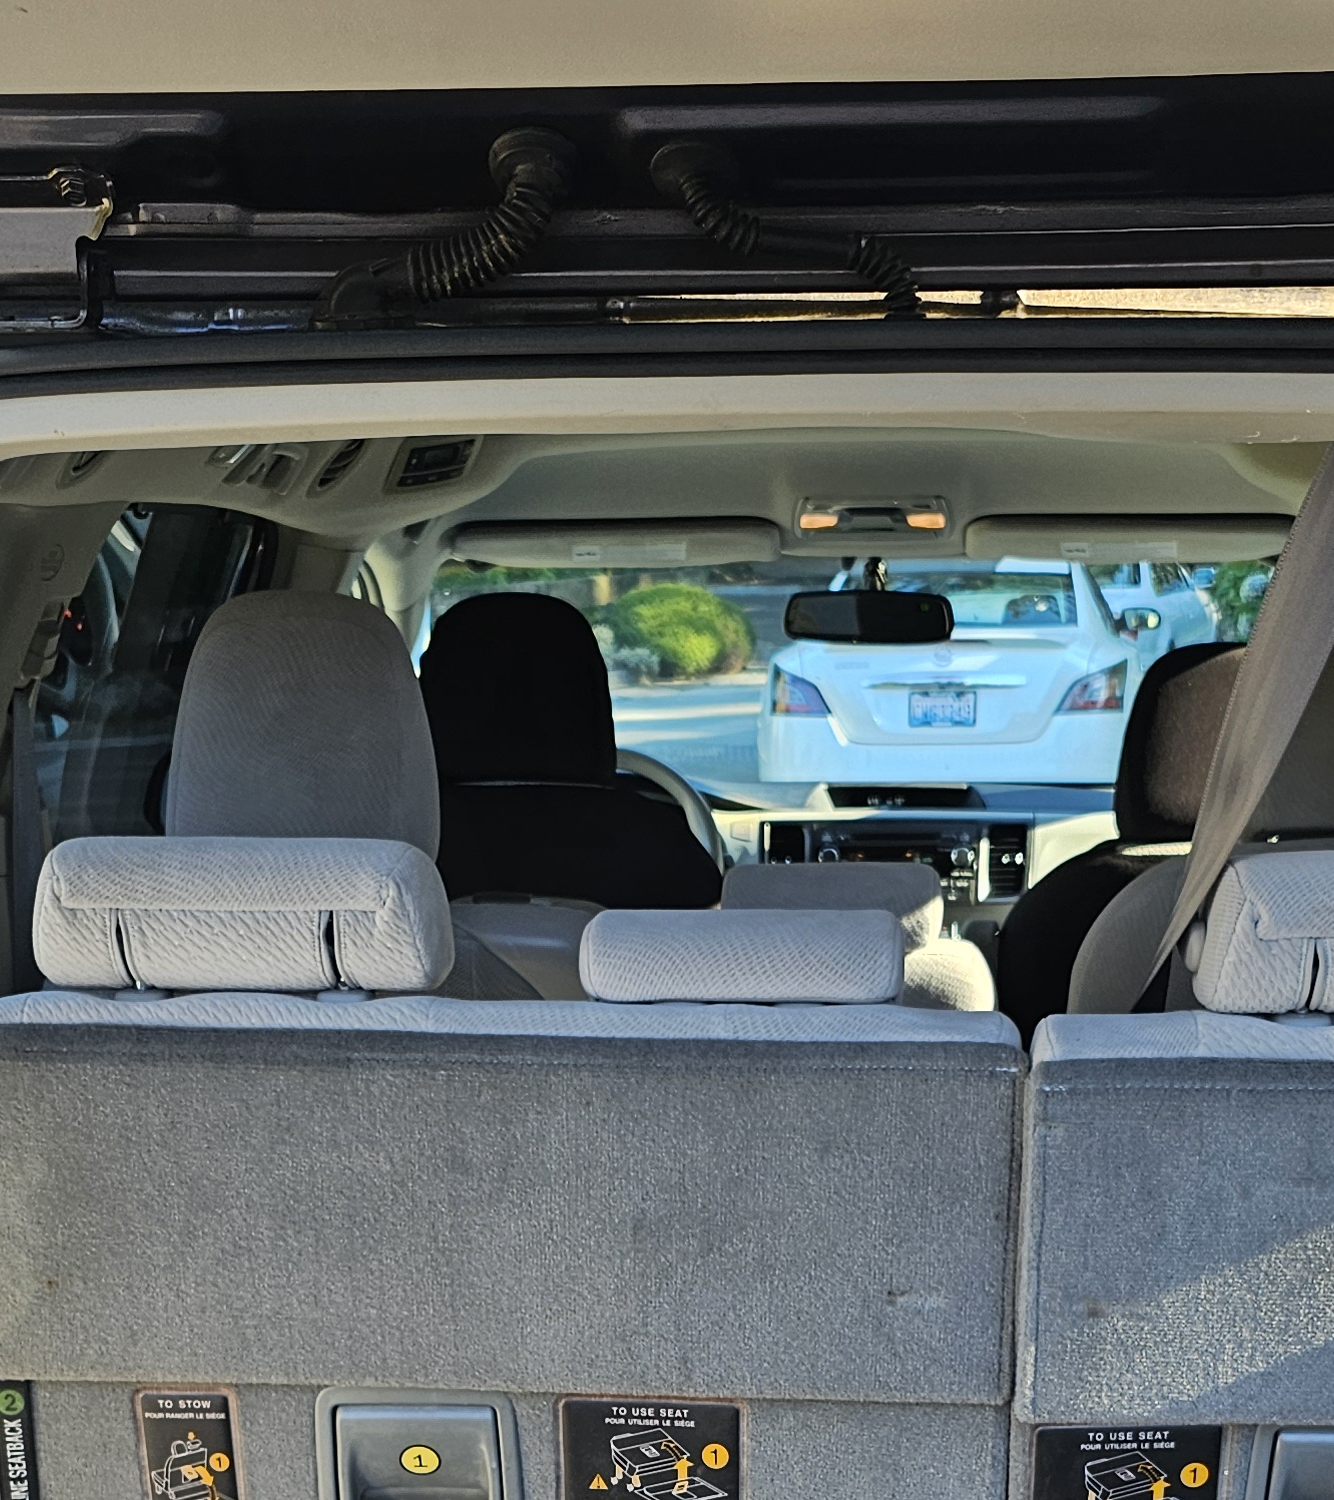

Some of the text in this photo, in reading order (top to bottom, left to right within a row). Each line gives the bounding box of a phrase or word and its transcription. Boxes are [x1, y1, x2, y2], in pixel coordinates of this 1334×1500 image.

[4, 1393, 19, 1412] 2
[158, 1400, 211, 1408] TO STOW
[612, 1407, 689, 1417] TO USE SEAT
[1088, 1431, 1169, 1441] TO USE SEAT
[4, 1418, 28, 1479] SEATBACK
[215, 1456, 223, 1469] 1
[414, 1454, 428, 1468] 1
[710, 1448, 719, 1465] 1
[1189, 1467, 1198, 1483] 1
